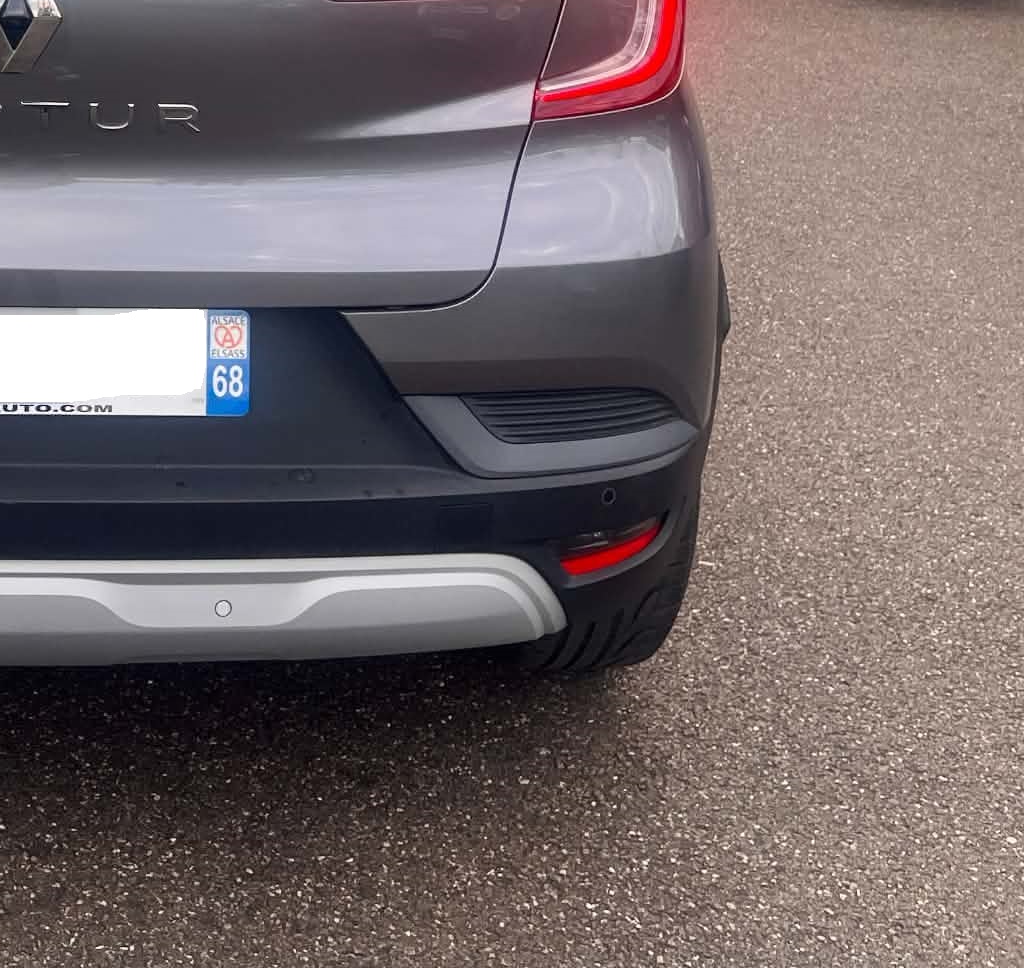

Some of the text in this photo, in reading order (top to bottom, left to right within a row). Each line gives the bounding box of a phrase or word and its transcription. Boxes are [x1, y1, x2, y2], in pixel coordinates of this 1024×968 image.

[211, 316, 246, 325] ALSACE
[211, 348, 246, 359] ELSASS
[212, 364, 244, 398] 68
